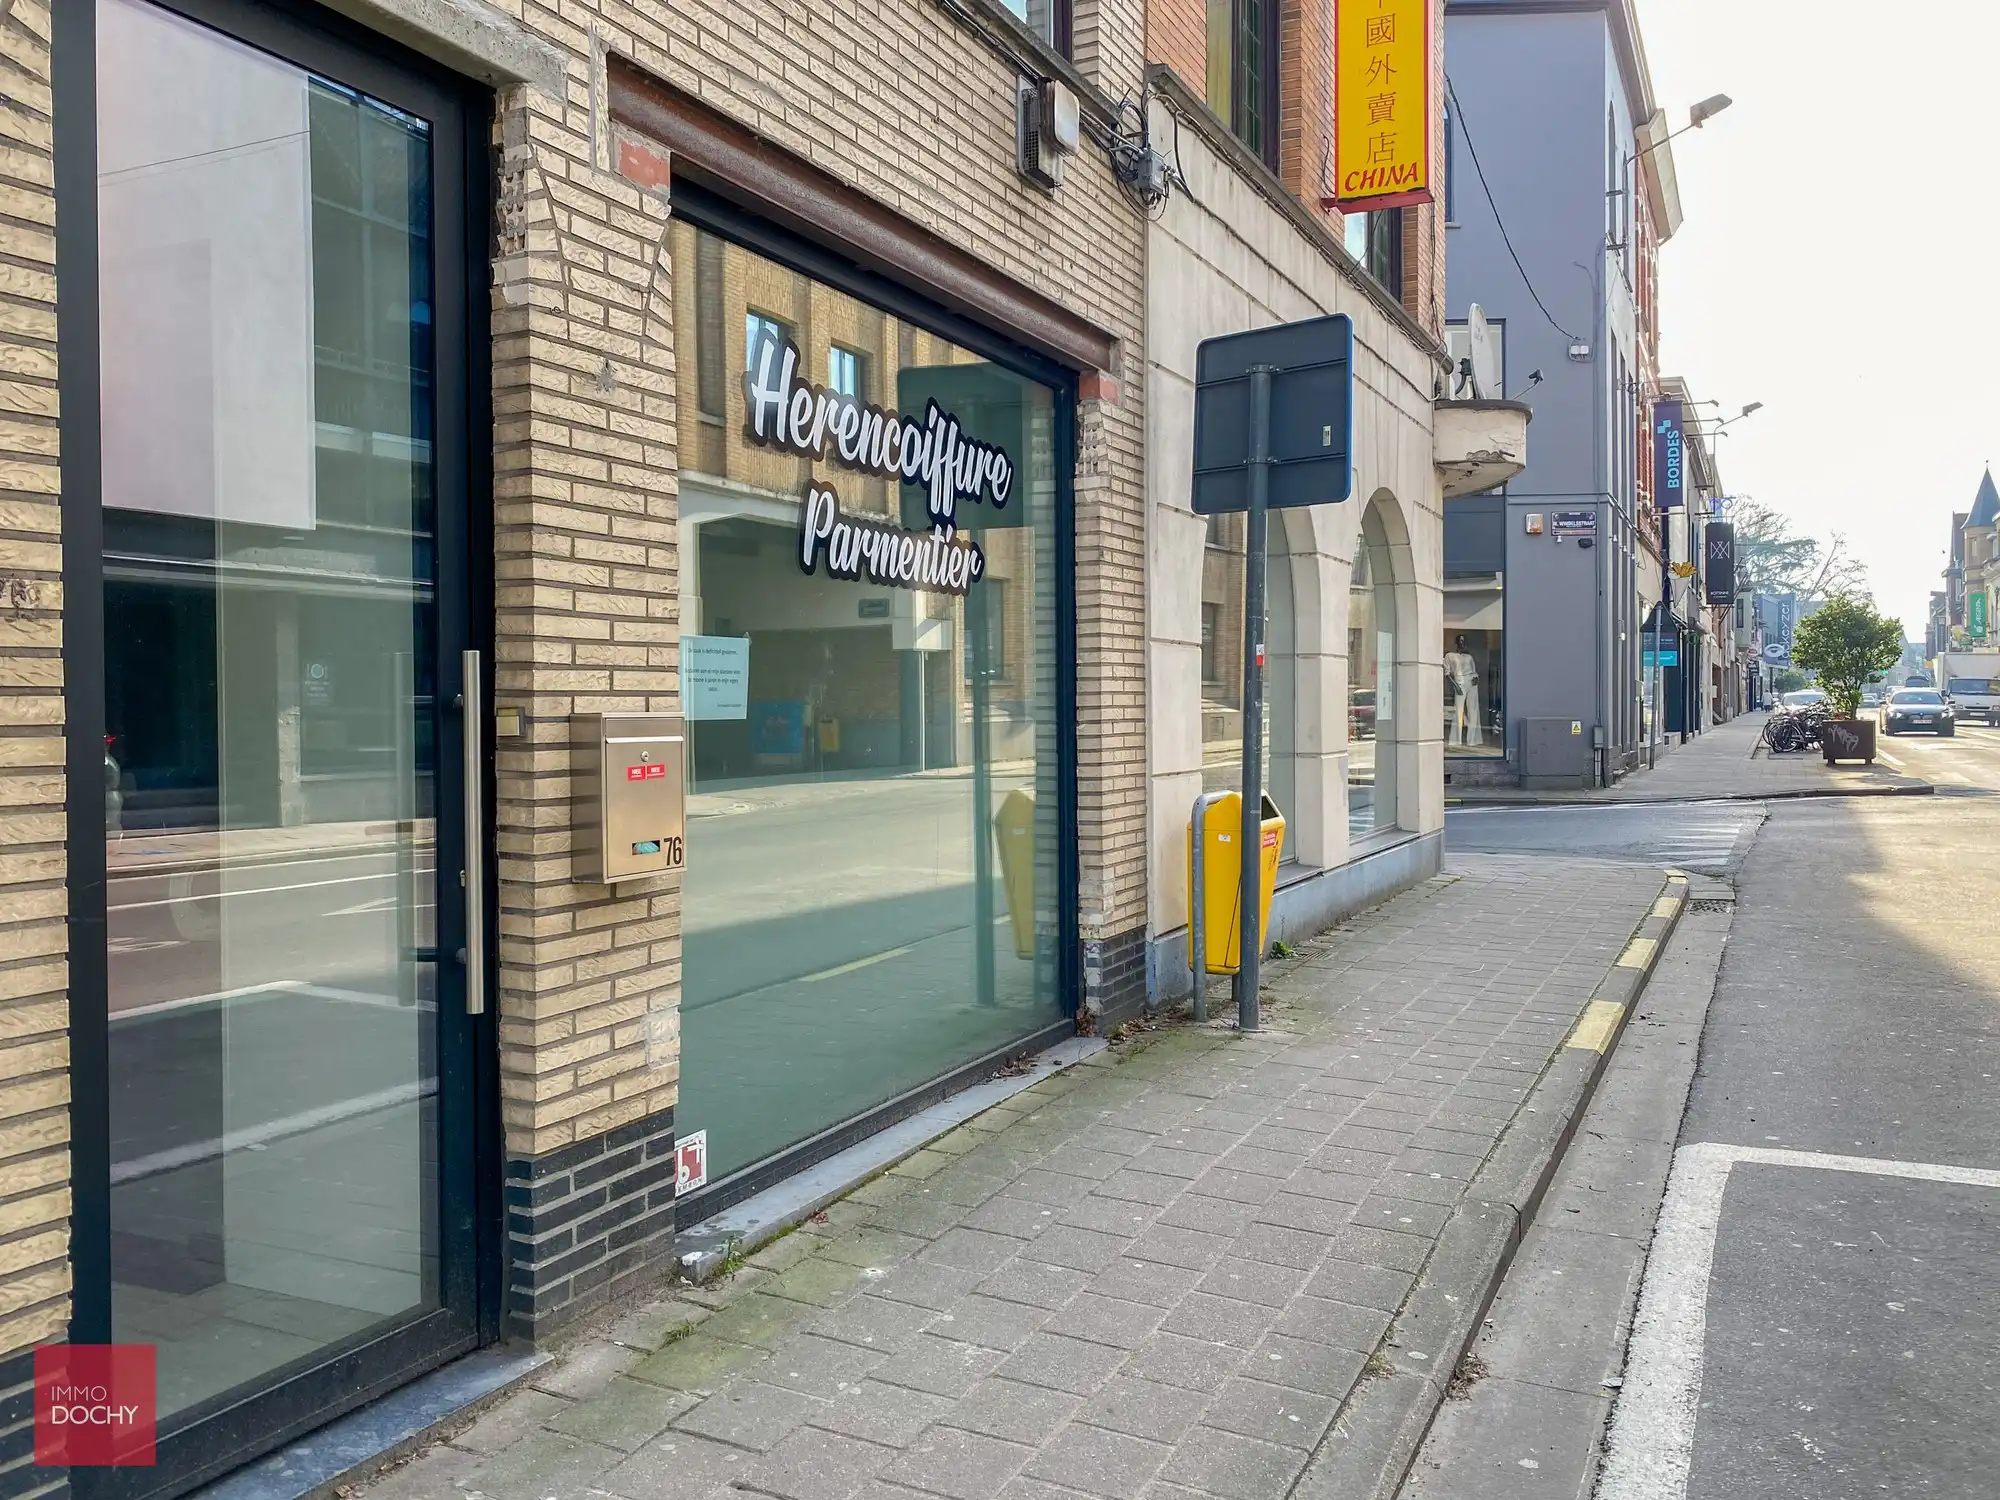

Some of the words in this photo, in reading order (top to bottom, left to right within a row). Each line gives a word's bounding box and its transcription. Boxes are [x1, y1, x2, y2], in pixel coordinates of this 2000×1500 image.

[1365, 0, 1398, 165] 國外賣店
[1345, 161, 1419, 192] CHINA
[749, 334, 1013, 518] Herencoiffure
[1667, 429, 1680, 489] BORDES
[802, 487, 982, 589] Parmentier
[663, 836, 682, 866] 76
